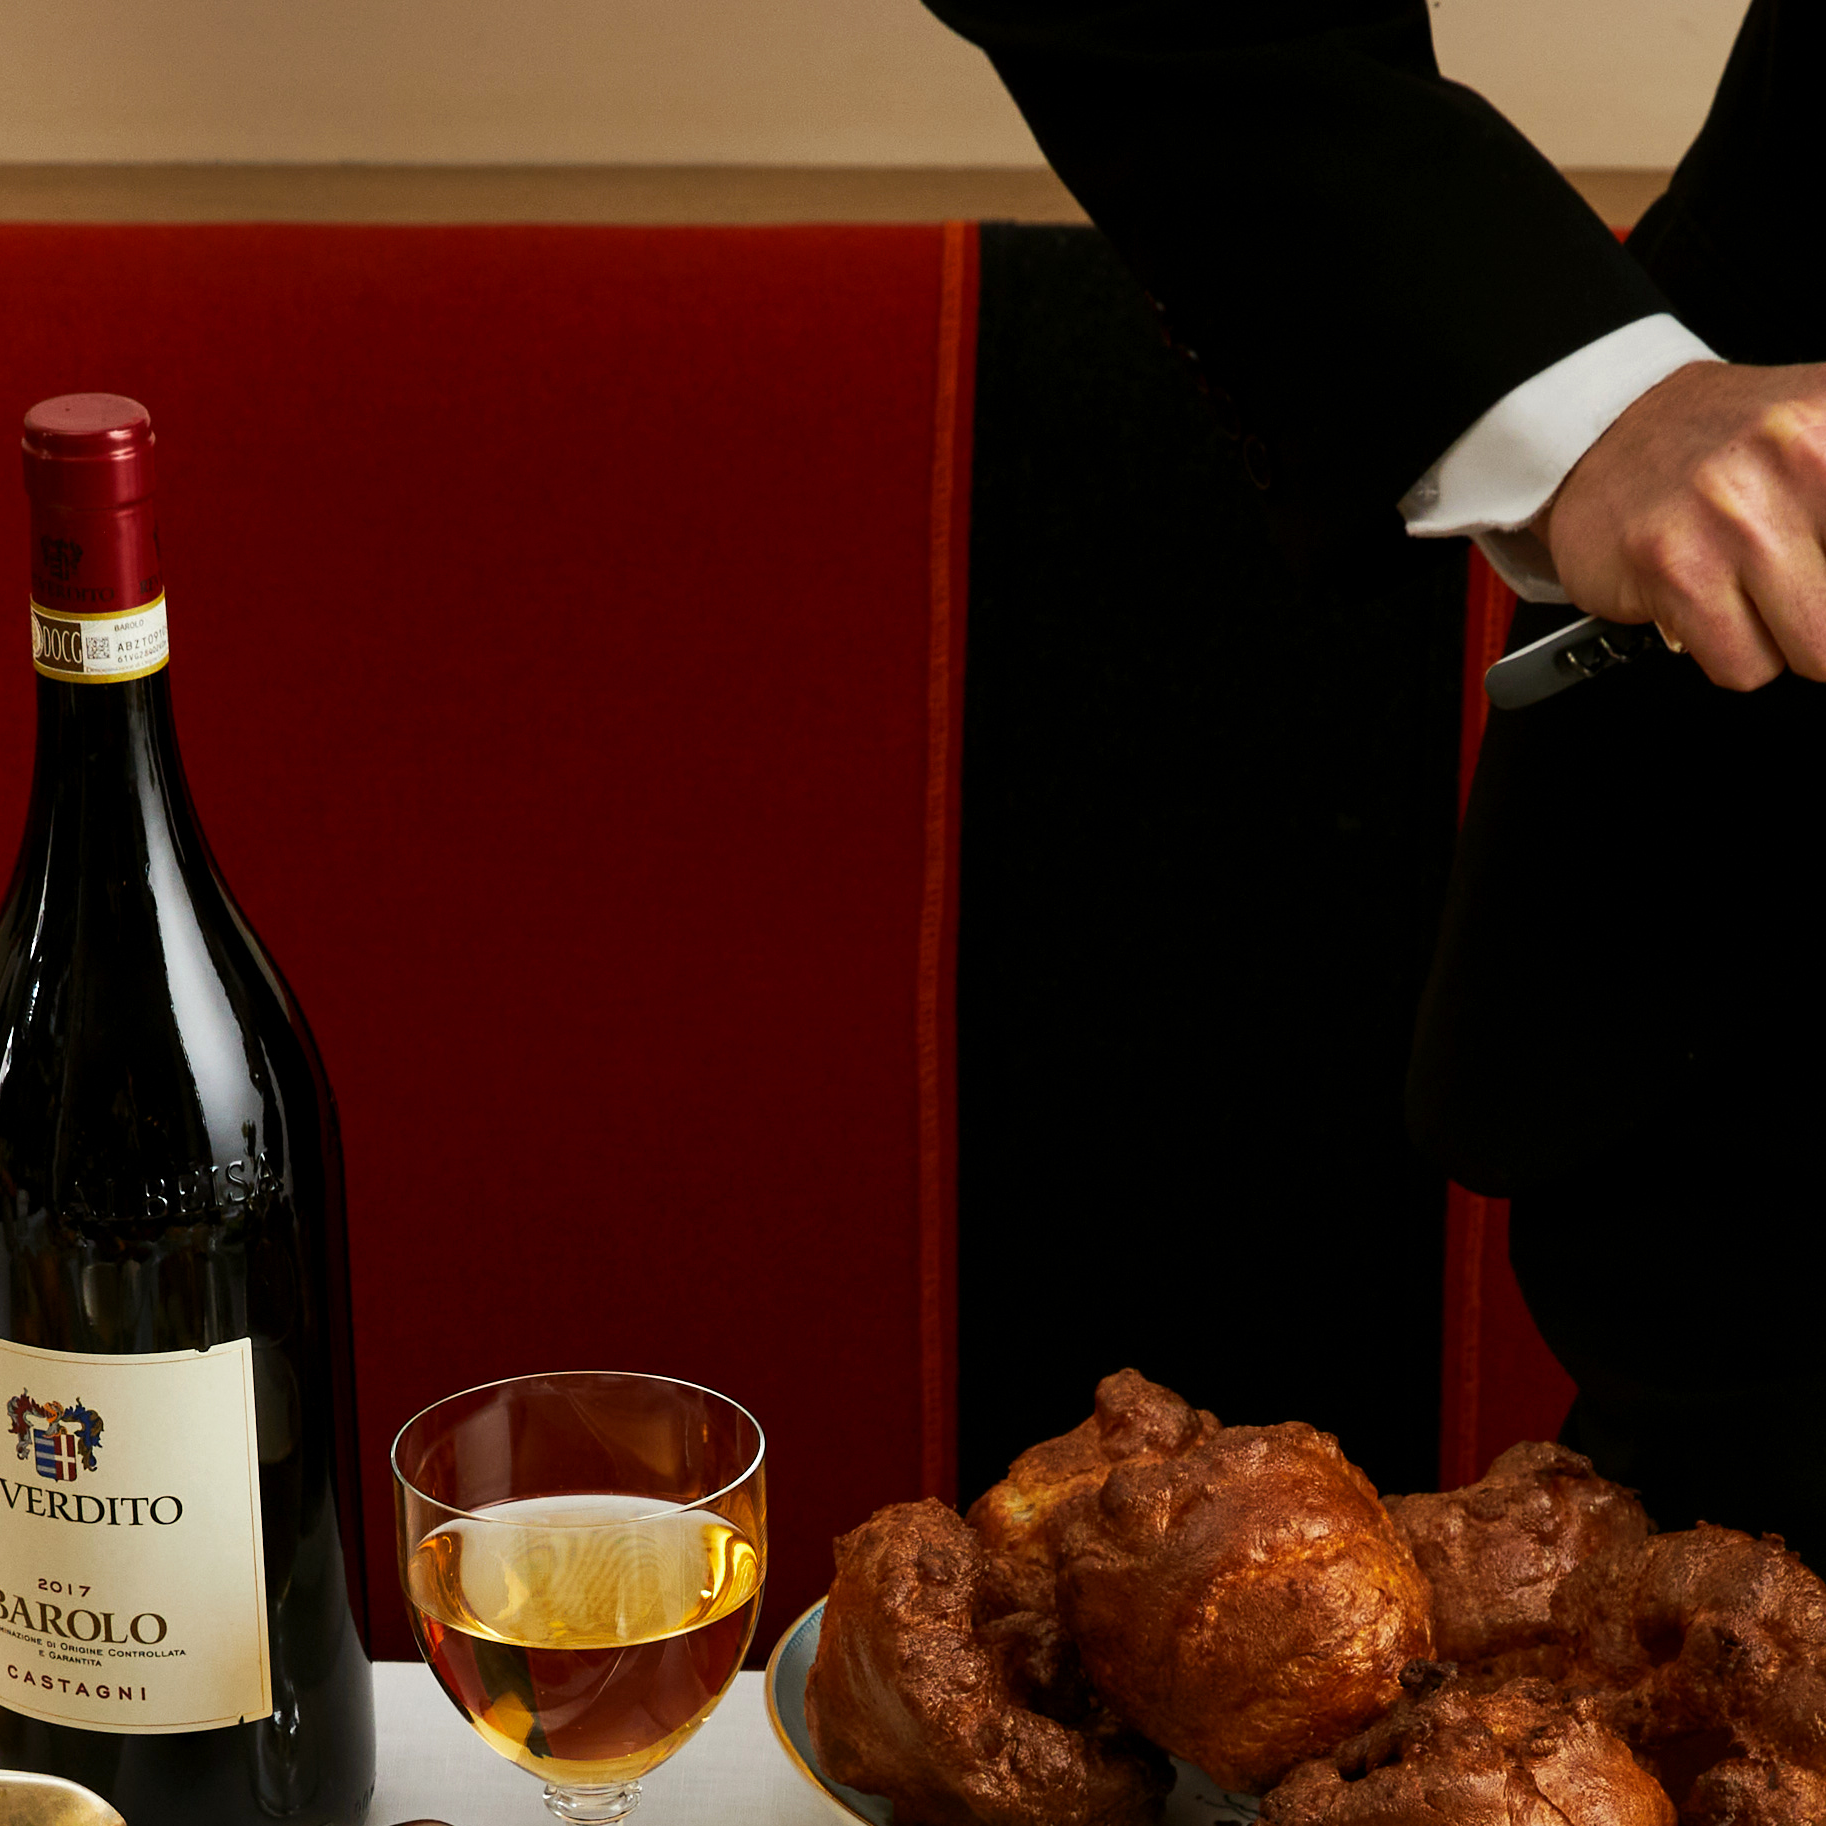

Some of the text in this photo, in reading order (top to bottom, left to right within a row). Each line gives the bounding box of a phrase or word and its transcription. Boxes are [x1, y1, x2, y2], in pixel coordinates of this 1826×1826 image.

[114, 619, 144, 632] BAROLO
[42, 626, 83, 664] DOCG
[38, 1577, 91, 1598] 2017
[7, 1664, 147, 1701] CASTAGNI
